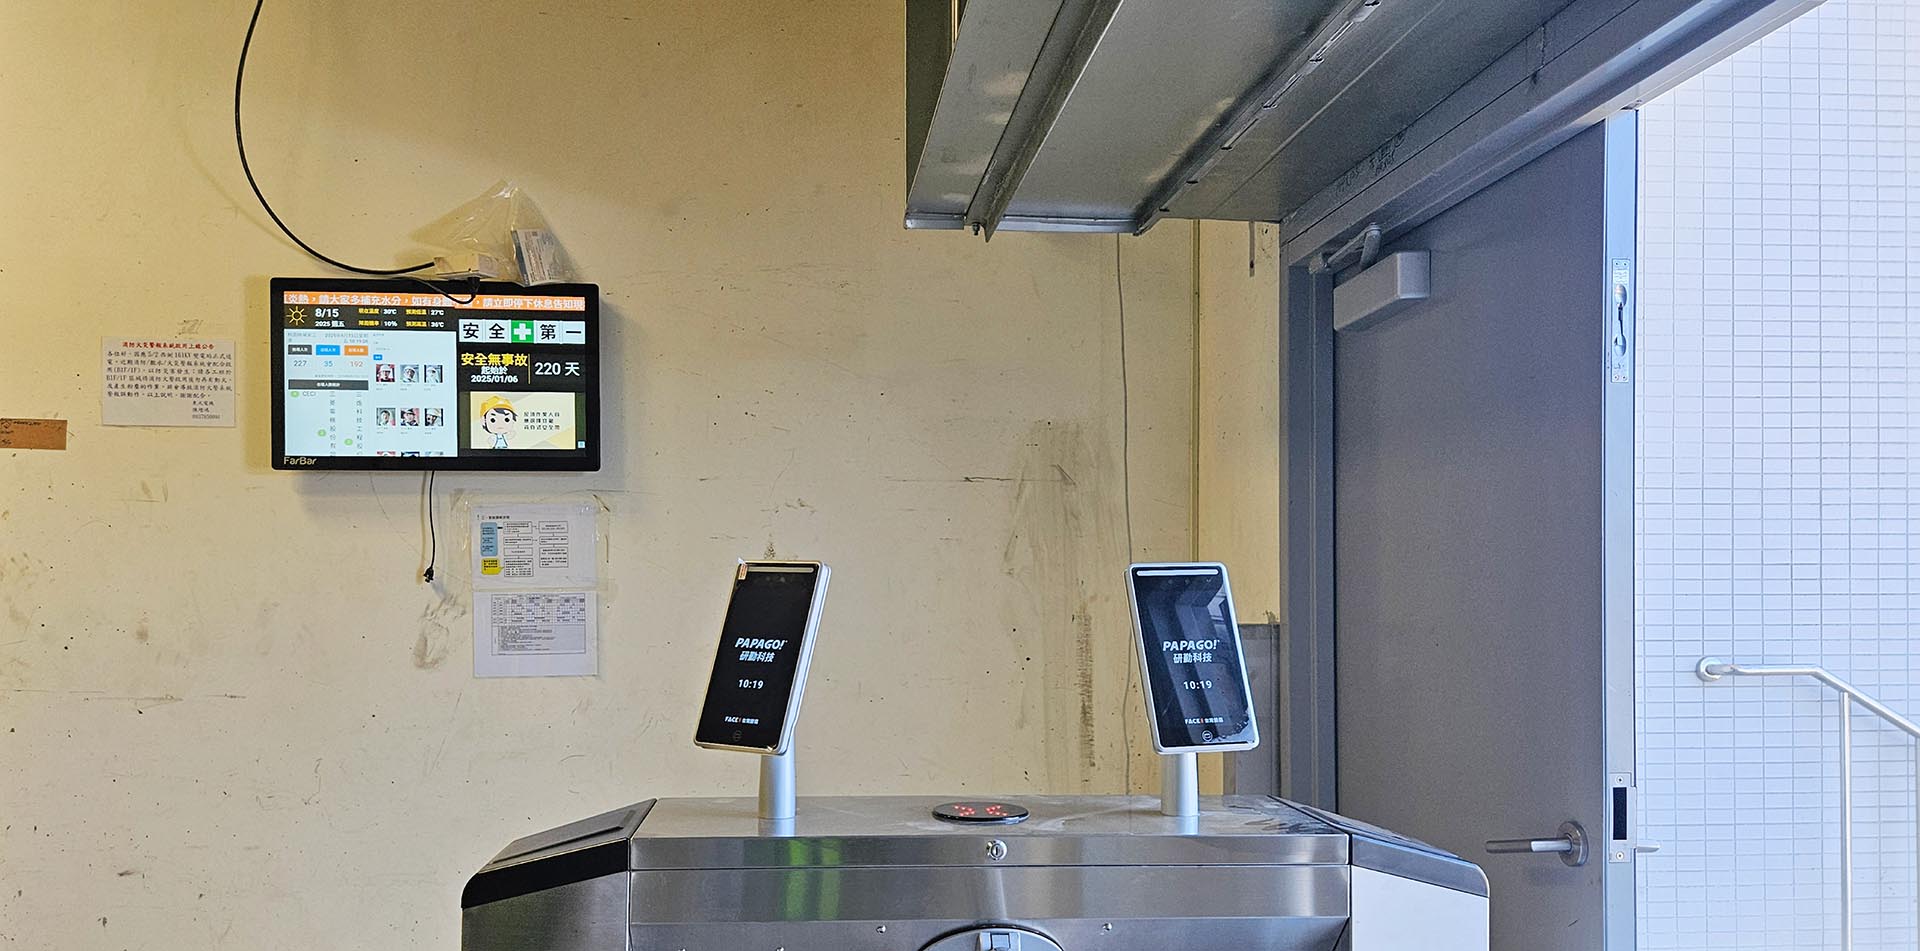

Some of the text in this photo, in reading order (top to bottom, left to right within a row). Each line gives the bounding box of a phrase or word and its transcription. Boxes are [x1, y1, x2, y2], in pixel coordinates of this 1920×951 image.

[315, 308, 339, 318] 8/15
[461, 353, 528, 367] 安全無事故
[481, 366, 508, 375] 起始於
[534, 362, 580, 377] 220 天
[470, 375, 518, 383] 2025/01/06
[283, 457, 317, 465] FarBar
[735, 637, 786, 650] PAPAGO!
[1163, 640, 1218, 651] PAPAGO!
[739, 651, 775, 662] 研勤科技
[1173, 652, 1213, 663] 研勤科技
[738, 679, 764, 689] 10:19
[1183, 680, 1212, 689] 10:19
